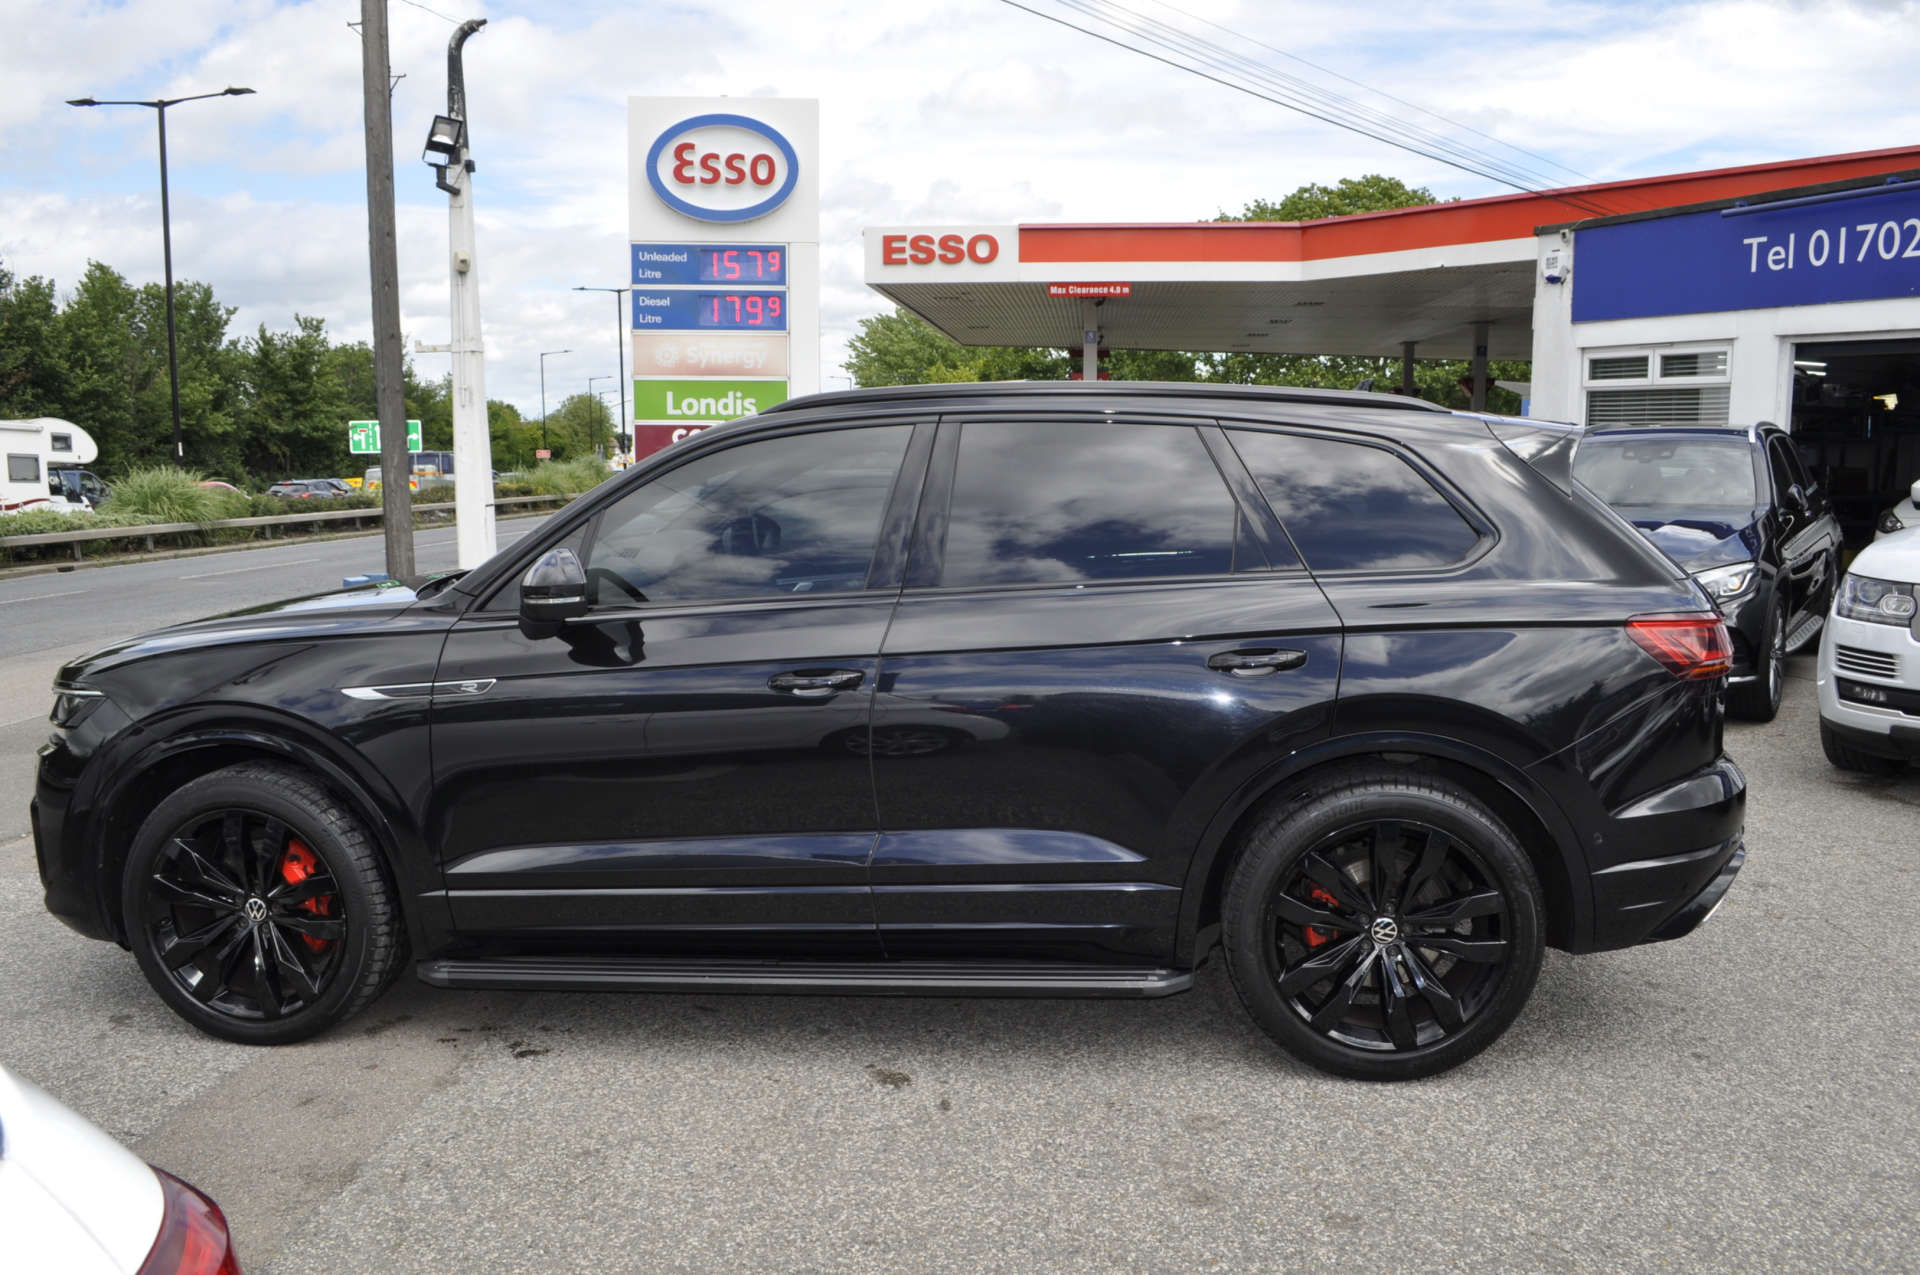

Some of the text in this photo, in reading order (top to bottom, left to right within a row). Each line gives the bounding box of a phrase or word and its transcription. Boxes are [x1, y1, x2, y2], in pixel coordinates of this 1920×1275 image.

[673, 142, 776, 186] Esso
[882, 233, 1000, 265] ESSO
[1743, 218, 1920, 273] Tel 01702
[638, 251, 688, 263] Unleaded
[638, 268, 663, 279] Litre
[1050, 286, 1066, 295] Max
[1068, 286, 1108, 295] Clearance
[639, 296, 671, 307] Diesel
[639, 313, 663, 324] Litre
[687, 344, 769, 369] Synergy
[666, 390, 759, 416] Londis
